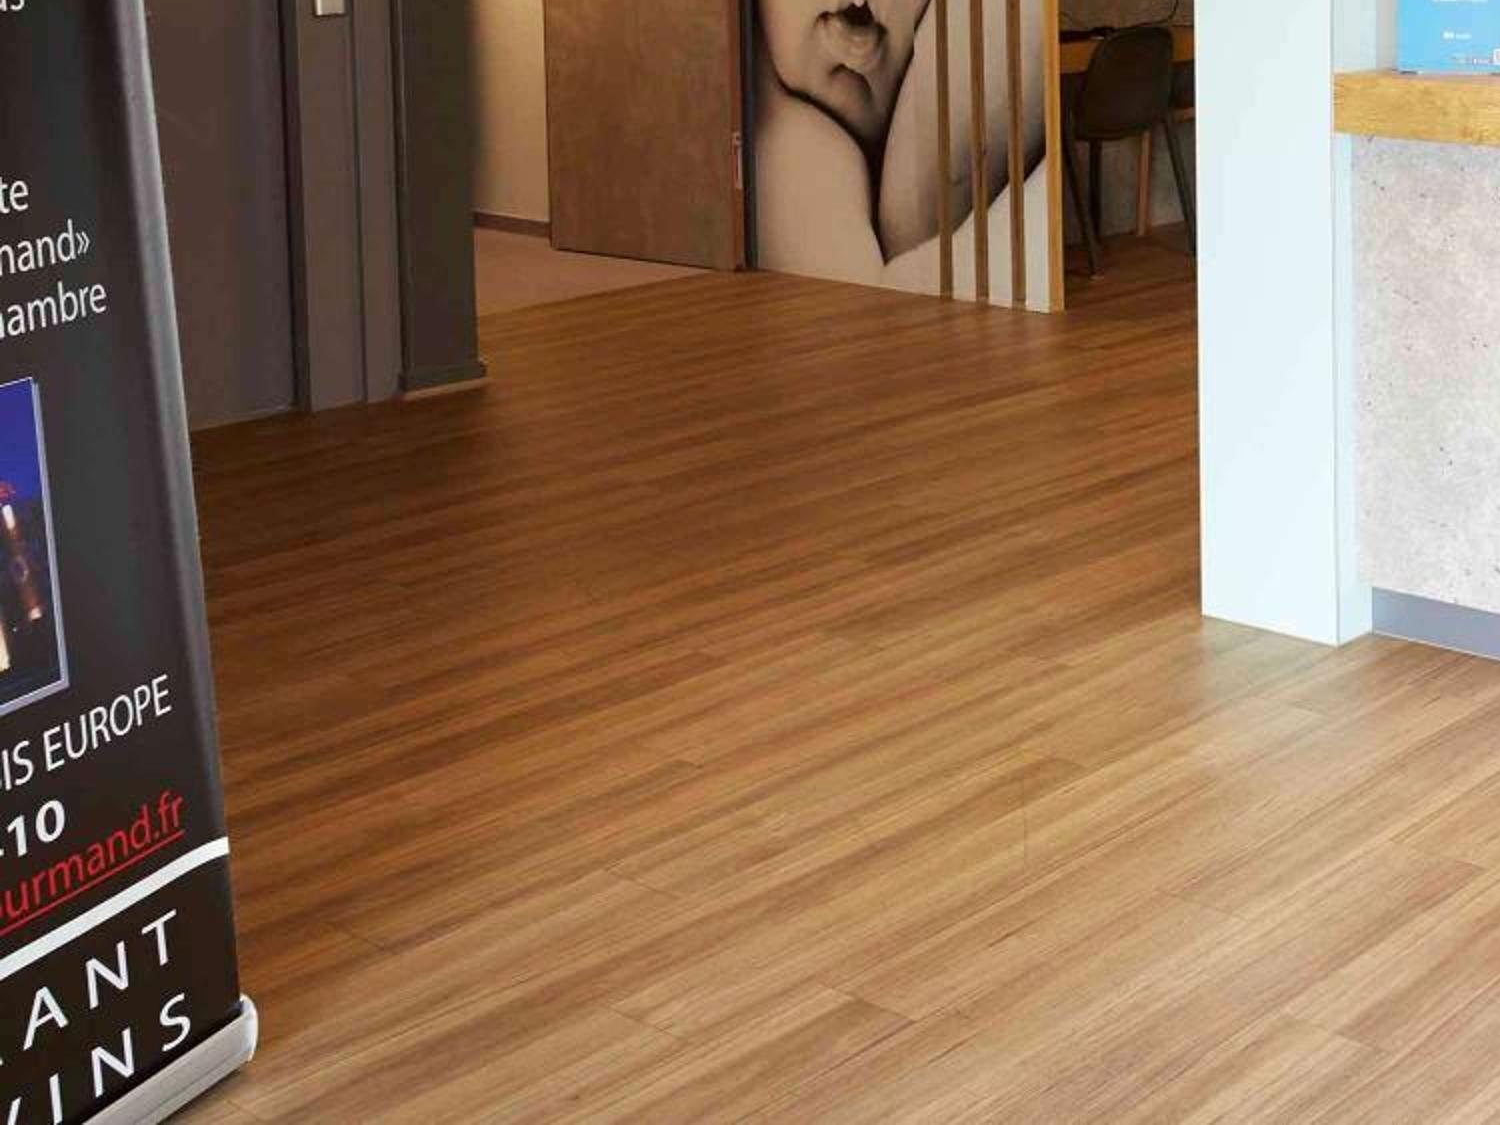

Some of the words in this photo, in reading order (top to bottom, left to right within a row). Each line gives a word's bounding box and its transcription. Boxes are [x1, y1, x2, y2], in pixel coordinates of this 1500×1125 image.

[0, 281, 107, 341] ambre
[0, 740, 35, 791] IS
[43, 674, 173, 772] EUROPE
[0, 790, 185, 919] urmand.fr
[0, 909, 177, 1066] ANT
